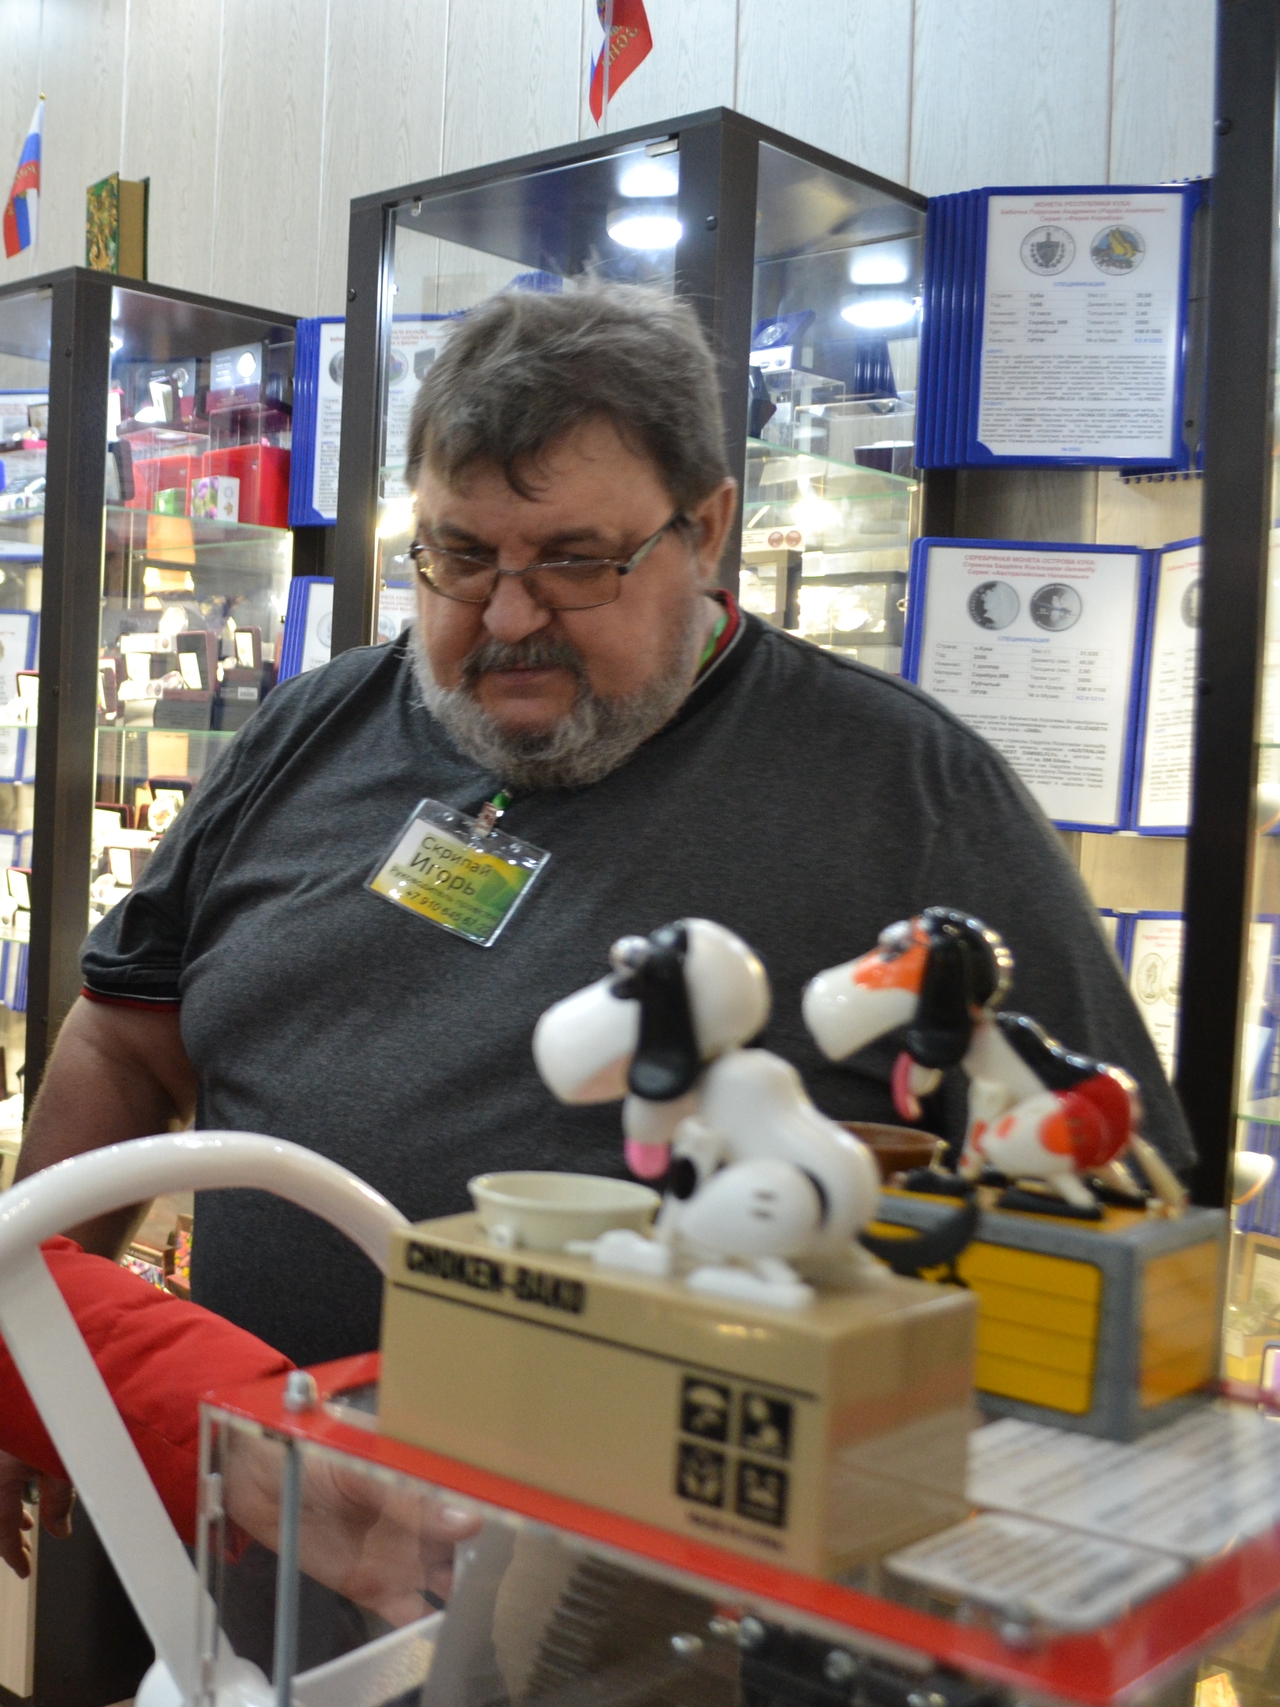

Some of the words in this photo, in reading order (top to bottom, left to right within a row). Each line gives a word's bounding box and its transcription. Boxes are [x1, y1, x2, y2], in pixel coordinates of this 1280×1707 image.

[1012, 556, 1040, 564] МОНЕТА
[1043, 557, 1076, 565] ОСТРОВА
[998, 635, 1050, 643] СПЕЦИФИКАЦИЯ
[421, 836, 493, 878] Скрипай
[409, 852, 477, 897] Игорь
